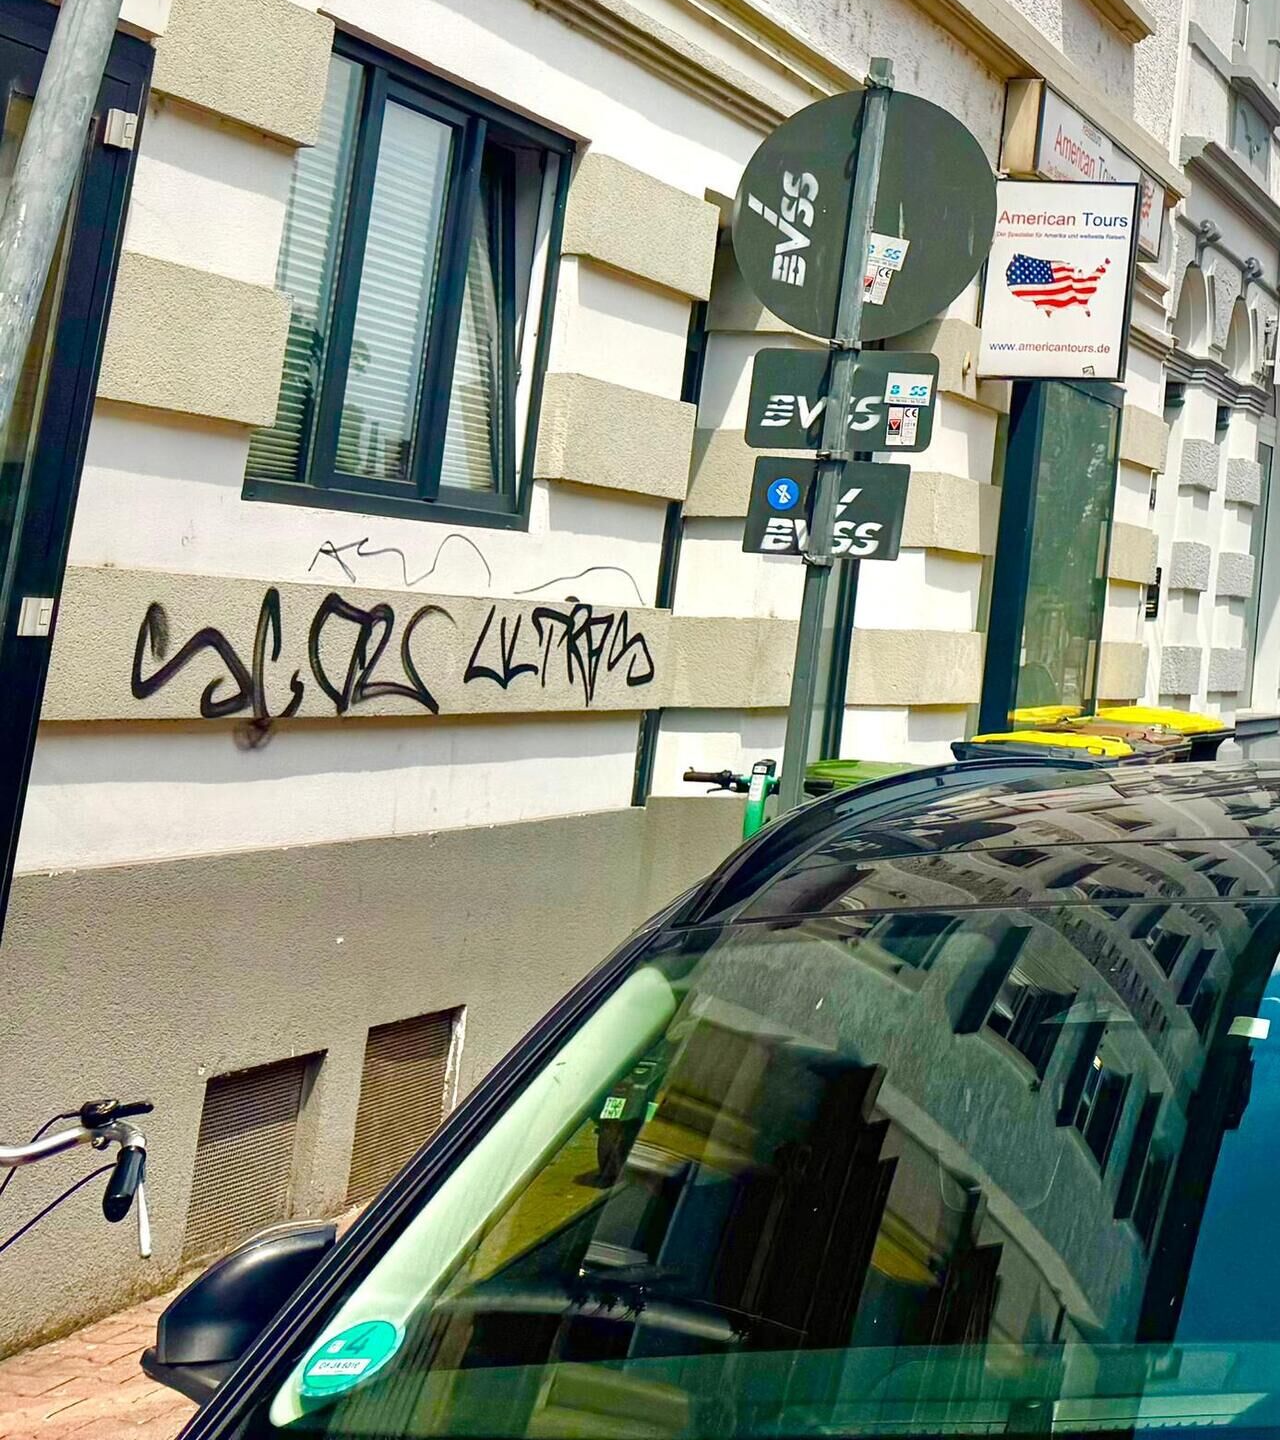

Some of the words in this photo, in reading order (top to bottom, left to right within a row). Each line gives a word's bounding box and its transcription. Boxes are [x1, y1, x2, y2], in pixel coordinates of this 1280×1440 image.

[1054, 124, 1095, 180] American
[998, 210, 1076, 226] American
[1082, 212, 1128, 227] Tours
[989, 342, 1110, 354] www.americantours.de
[344, 1325, 378, 1354] 4
